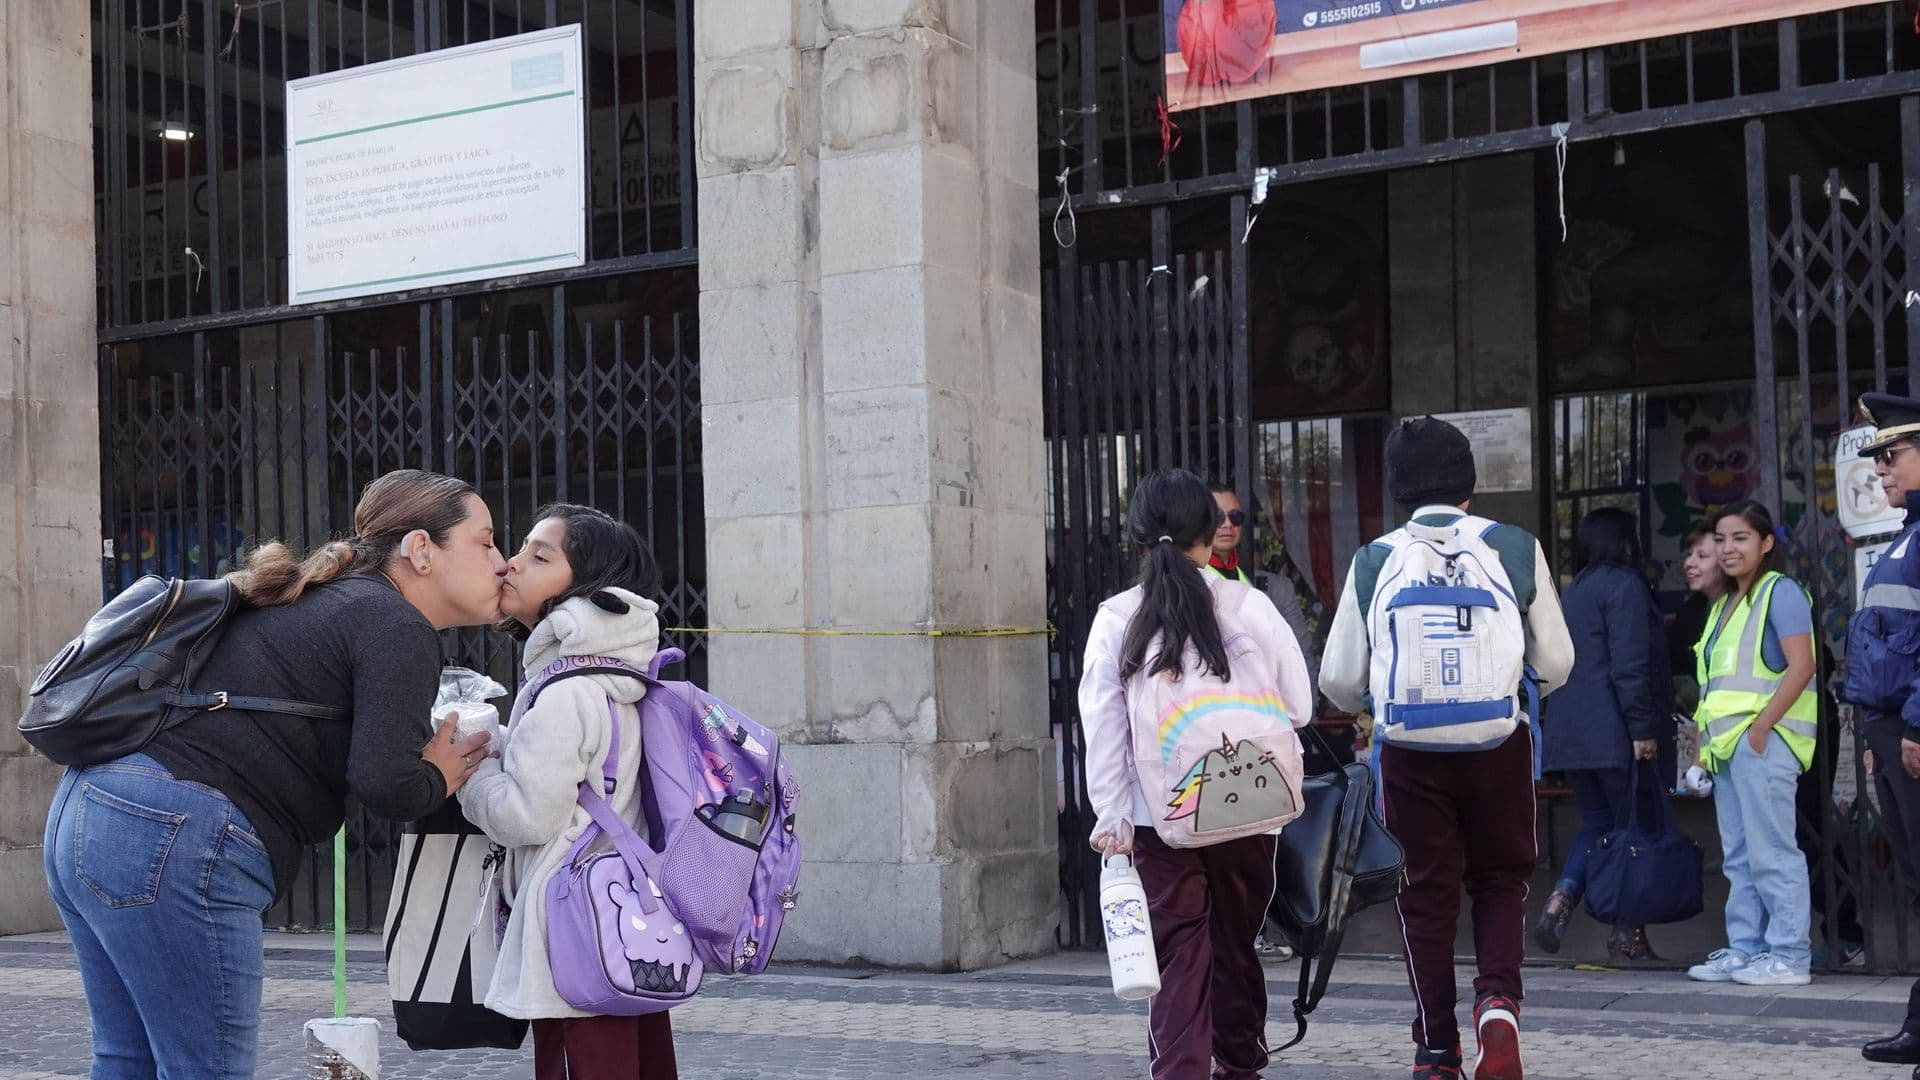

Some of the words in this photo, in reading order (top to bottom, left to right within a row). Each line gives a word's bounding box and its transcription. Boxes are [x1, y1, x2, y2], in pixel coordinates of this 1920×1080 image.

[1320, 1, 1382, 24] 5555102515
[326, 168, 360, 183] ESCUELA
[410, 152, 453, 169] GRATUITA
[442, 178, 480, 194] condicionar
[488, 172, 532, 189] permanencia
[552, 164, 565, 179] hijo
[313, 193, 325, 204] SEP
[358, 182, 395, 198] responsable
[466, 165, 494, 179] servicios
[496, 163, 505, 174] del
[427, 198, 439, 209] por
[484, 187, 503, 199] estos
